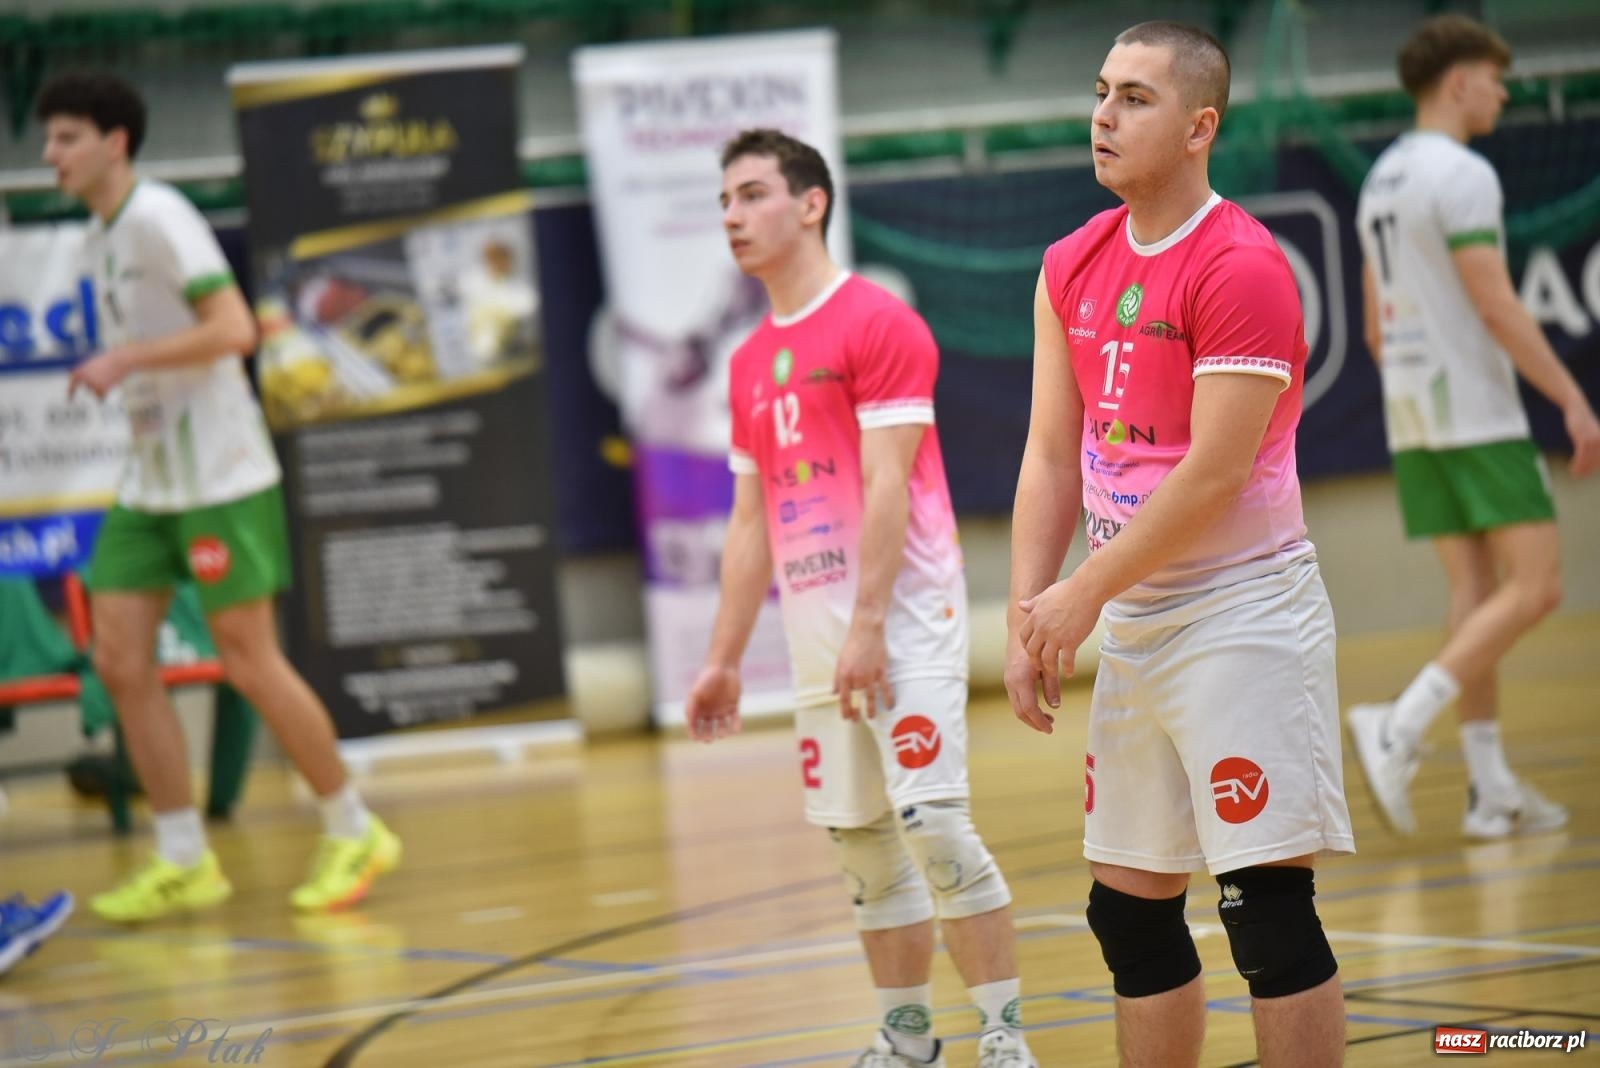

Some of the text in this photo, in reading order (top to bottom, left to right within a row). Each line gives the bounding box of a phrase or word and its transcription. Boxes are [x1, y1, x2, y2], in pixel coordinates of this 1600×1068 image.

[1098, 340, 1135, 398] 15
[798, 736, 823, 790] 2
[1211, 774, 1268, 809] RV
